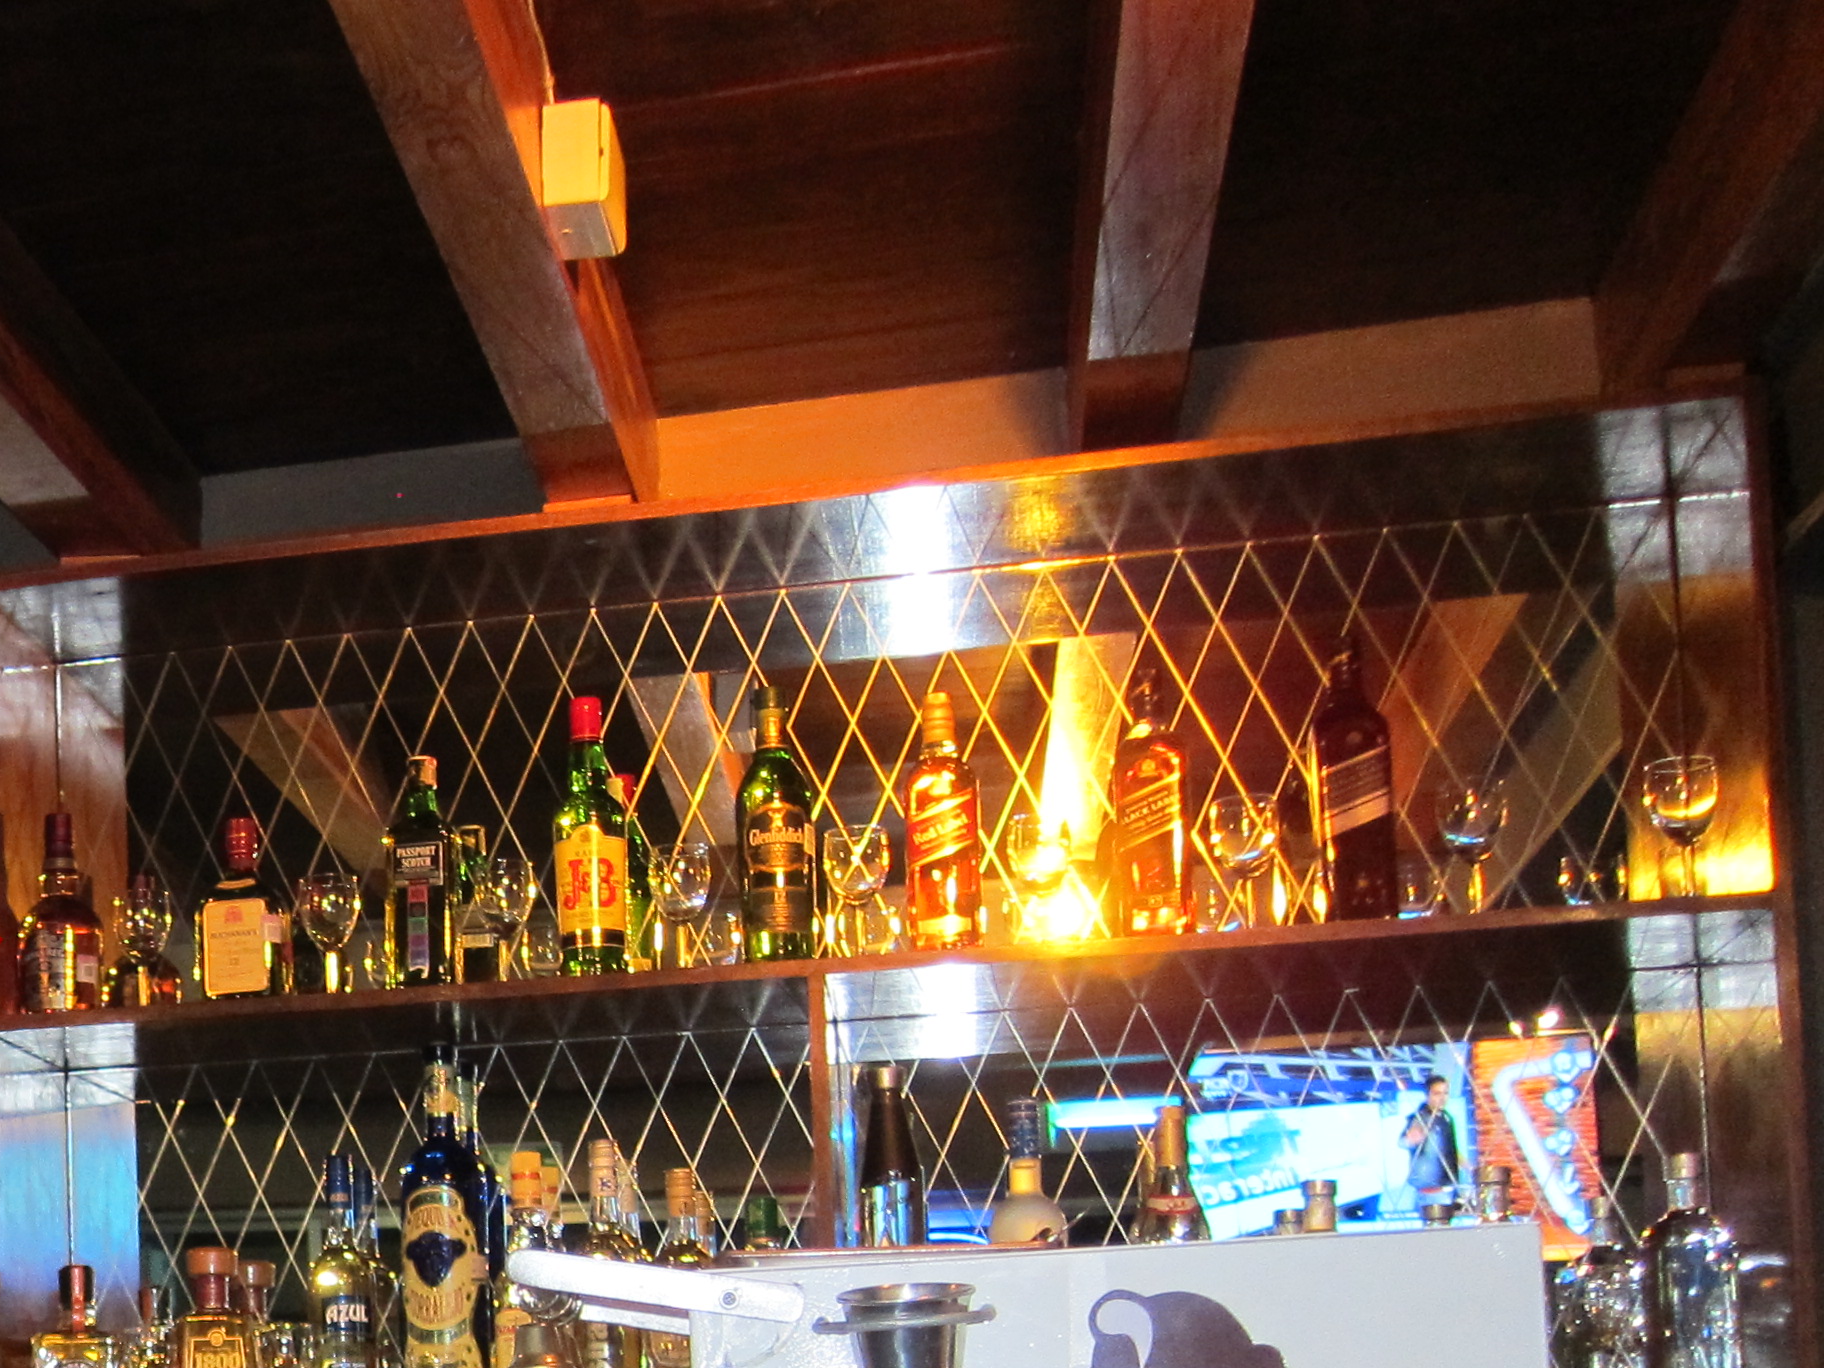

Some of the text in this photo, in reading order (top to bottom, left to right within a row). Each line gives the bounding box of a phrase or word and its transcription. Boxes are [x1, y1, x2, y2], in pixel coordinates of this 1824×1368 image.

[749, 826, 805, 846] Glenfiddich
[396, 845, 436, 858] PASSPORT
[401, 857, 432, 868] SCOTCH
[325, 1303, 369, 1324] AZUL
